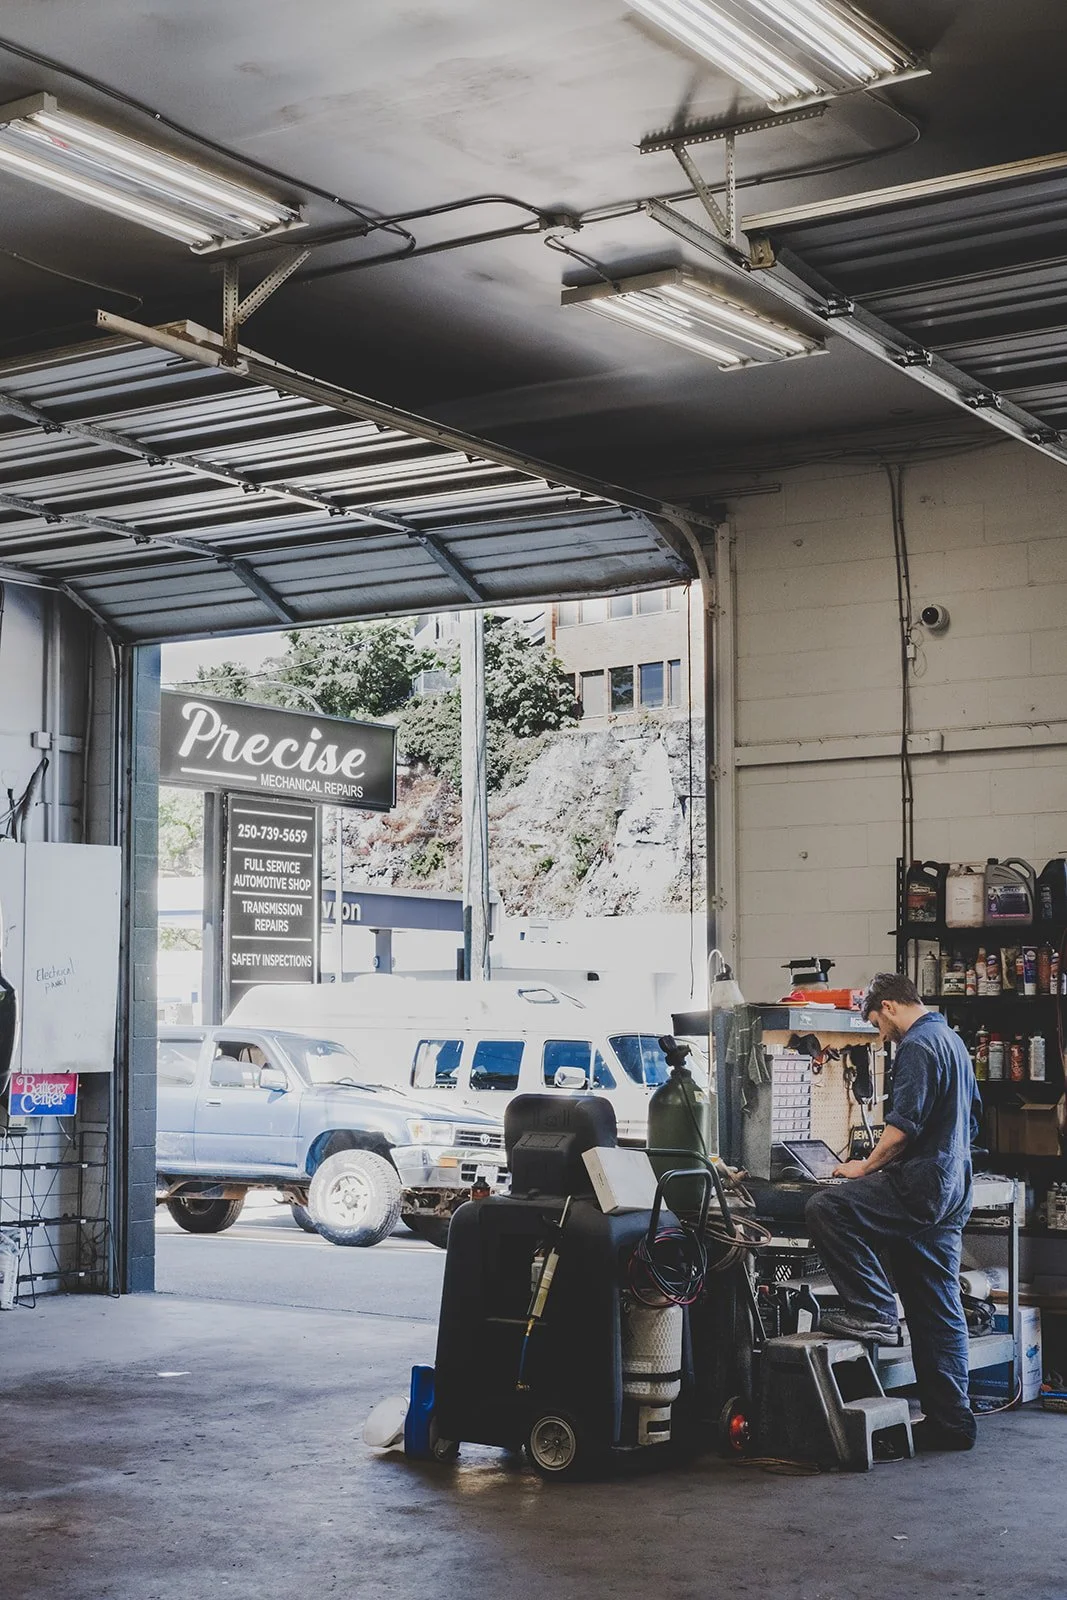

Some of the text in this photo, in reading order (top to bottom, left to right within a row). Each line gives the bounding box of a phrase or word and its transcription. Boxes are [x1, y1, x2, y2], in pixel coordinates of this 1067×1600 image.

[178, 702, 366, 778] Precise
[260, 773, 363, 798] MECHANICAL REPAIRS
[238, 824, 308, 843] 250-739-5659
[244, 858, 301, 874] FULL SERVICE
[233, 874, 311, 892] AUTOMOTIVE SHOP
[242, 901, 303, 916] TRANSMISSION
[255, 919, 289, 933] REPAIRS
[232, 953, 312, 968] SAFETY INSPECTIONS
[15, 1075, 69, 1095] Battery
[20, 1093, 67, 1113] Center
[853, 1129, 882, 1140] BEWRE
